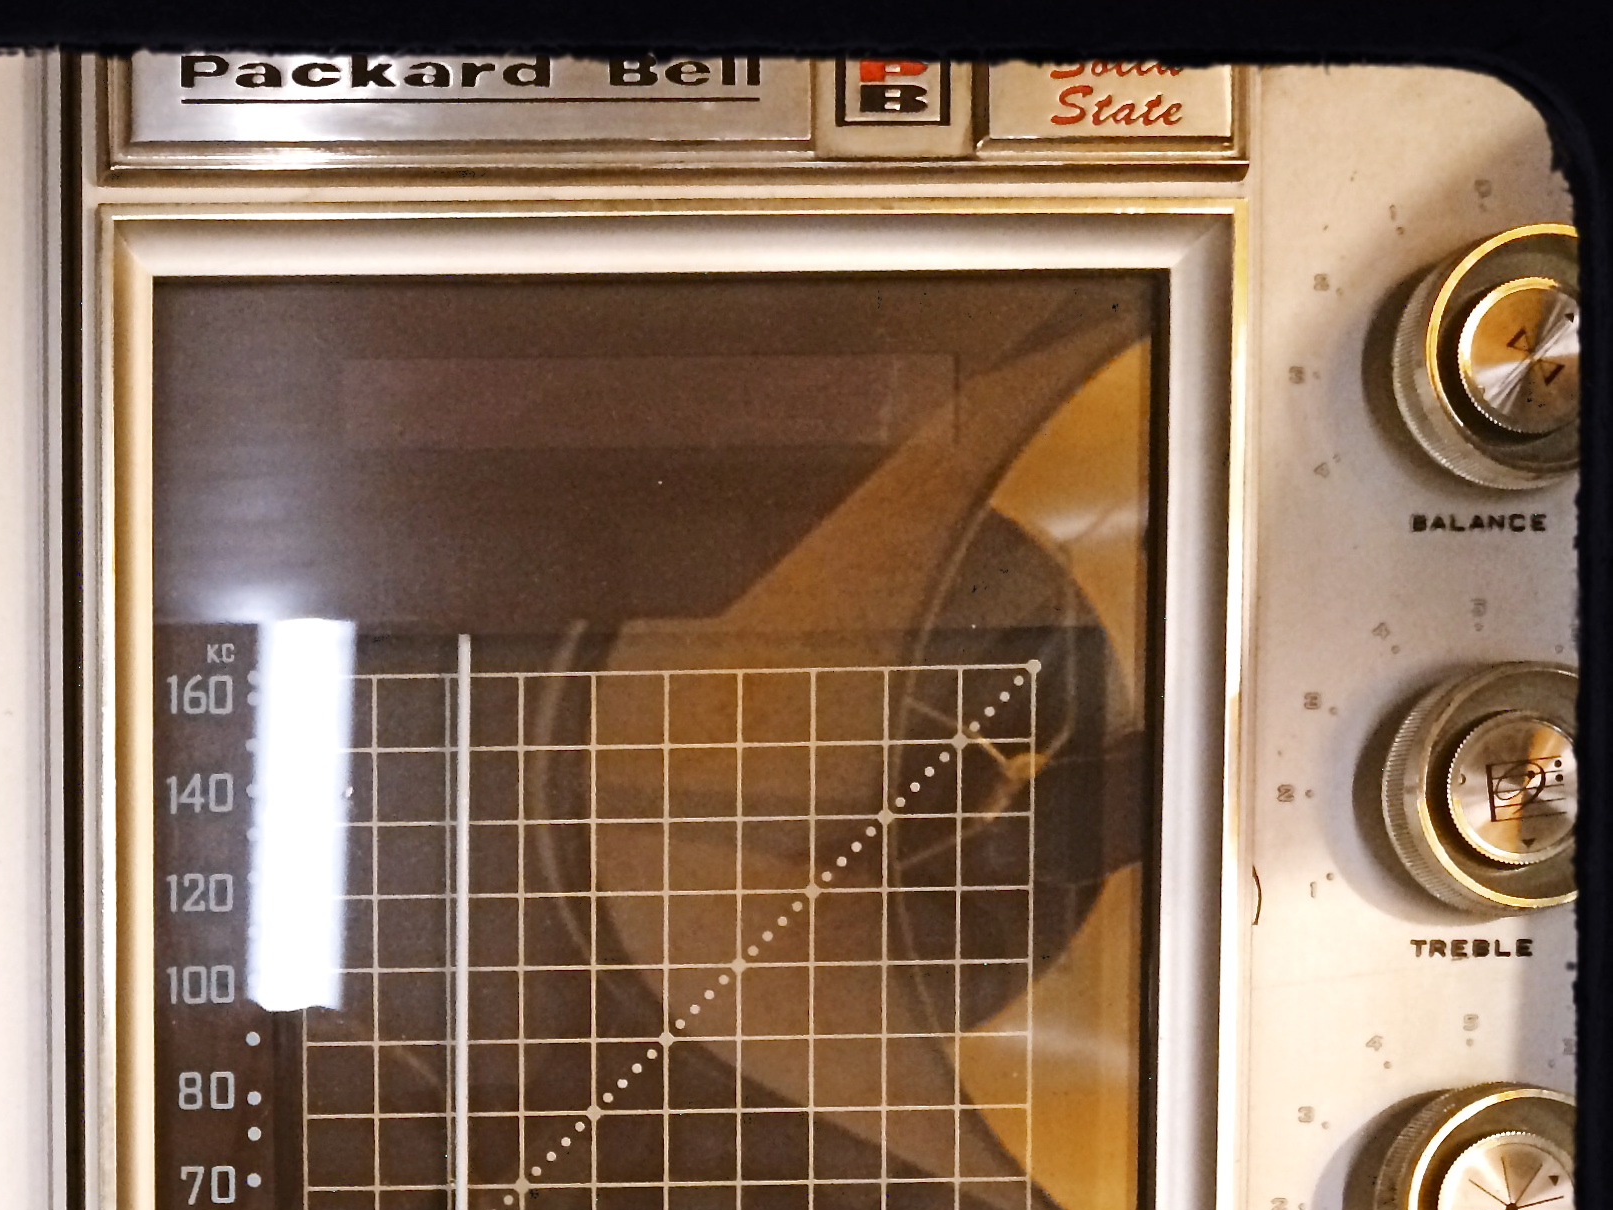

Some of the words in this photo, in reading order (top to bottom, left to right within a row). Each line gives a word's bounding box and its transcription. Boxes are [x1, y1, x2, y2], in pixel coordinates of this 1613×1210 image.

[181, 54, 550, 88] Packard
[609, 55, 761, 86] Bell
[1050, 84, 1183, 126] State
[1410, 514, 1547, 532] BALANCE
[207, 644, 235, 663] KC
[166, 674, 233, 715] 160
[166, 773, 234, 814] 140
[166, 873, 234, 913] 120
[1410, 939, 1533, 957] TREBLE
[166, 965, 235, 1005] 100
[178, 1071, 235, 1111] 80
[180, 1166, 236, 1205] 70
